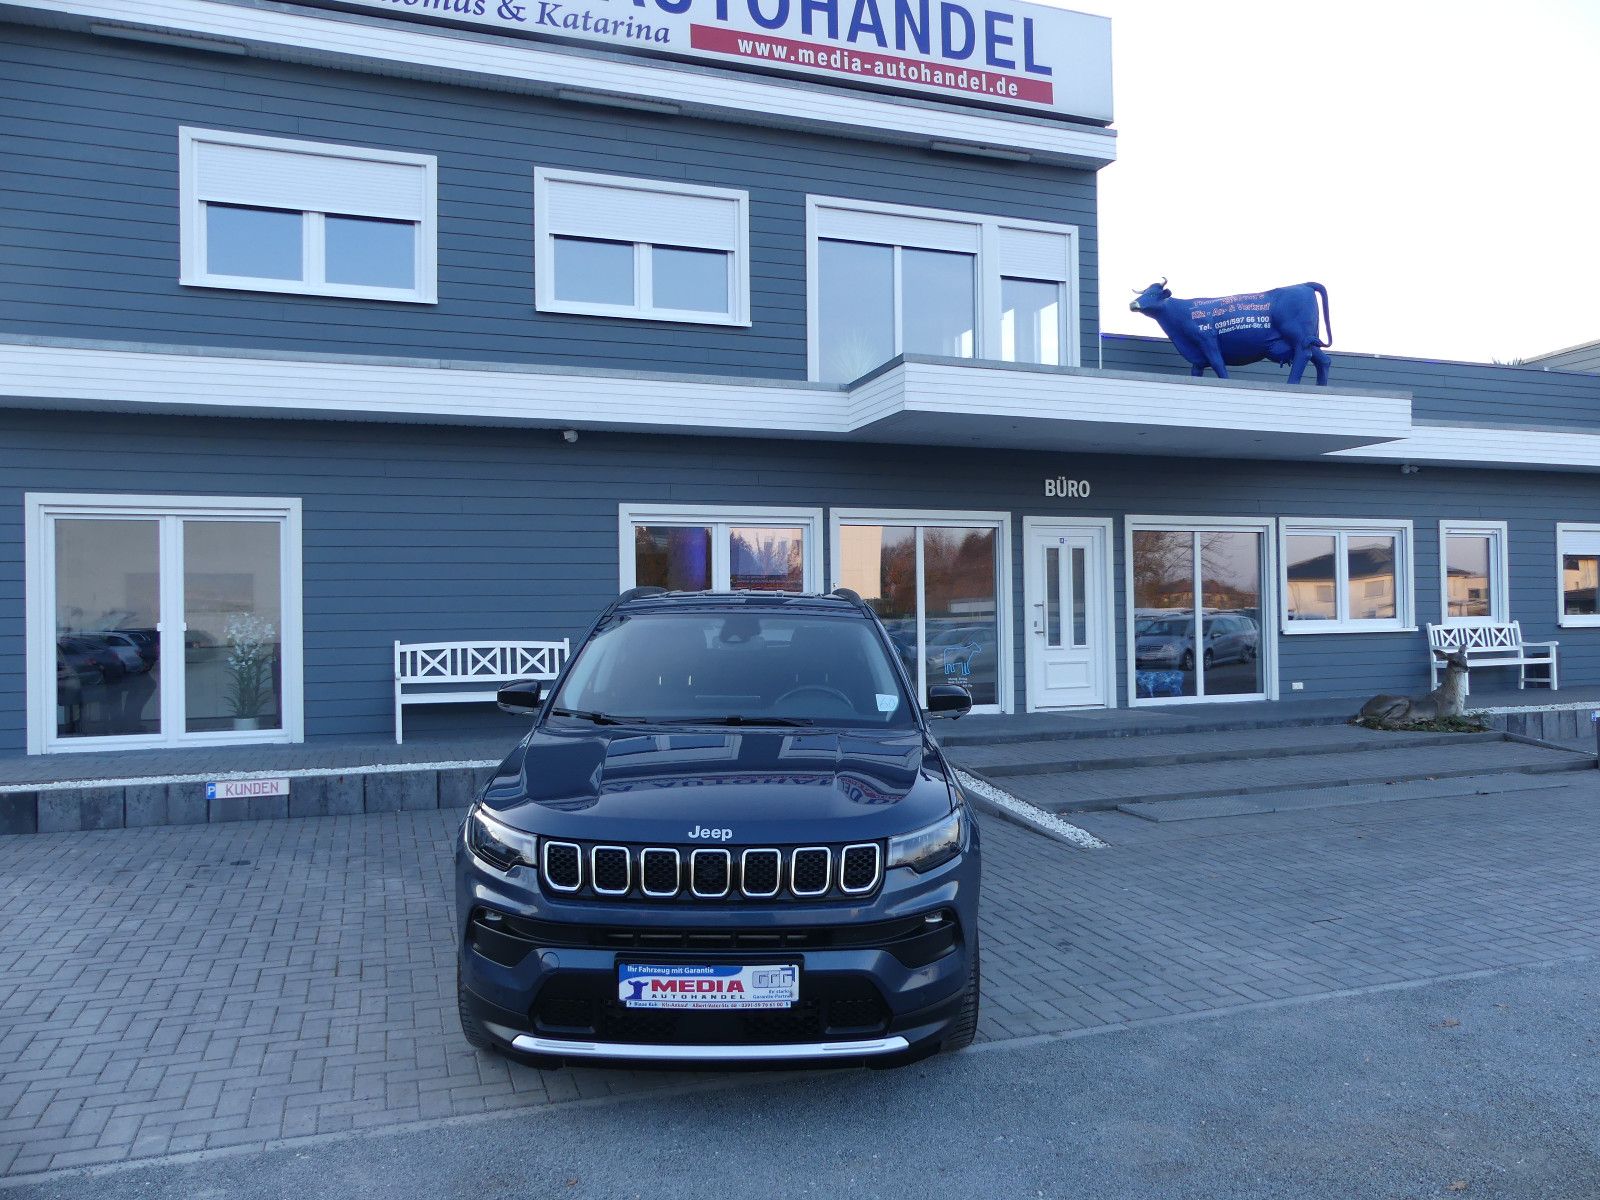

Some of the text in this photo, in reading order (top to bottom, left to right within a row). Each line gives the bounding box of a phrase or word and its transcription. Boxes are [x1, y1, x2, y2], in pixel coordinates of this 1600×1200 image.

[497, 0, 528, 23] &
[535, 1, 671, 43] Katarina
[738, 36, 1019, 97] www.media-autohandel.de
[1198, 323, 1212, 331] Tel.
[1214, 316, 1244, 329] 0391/597
[1257, 315, 1270, 323] 100
[1045, 476, 1091, 498] BÜRO
[225, 781, 279, 797] KUNDEN
[688, 825, 733, 842] Jeep
[627, 965, 637, 973] Ihr
[639, 966, 670, 975] Fahrzeug
[651, 979, 745, 993] MEDIA
